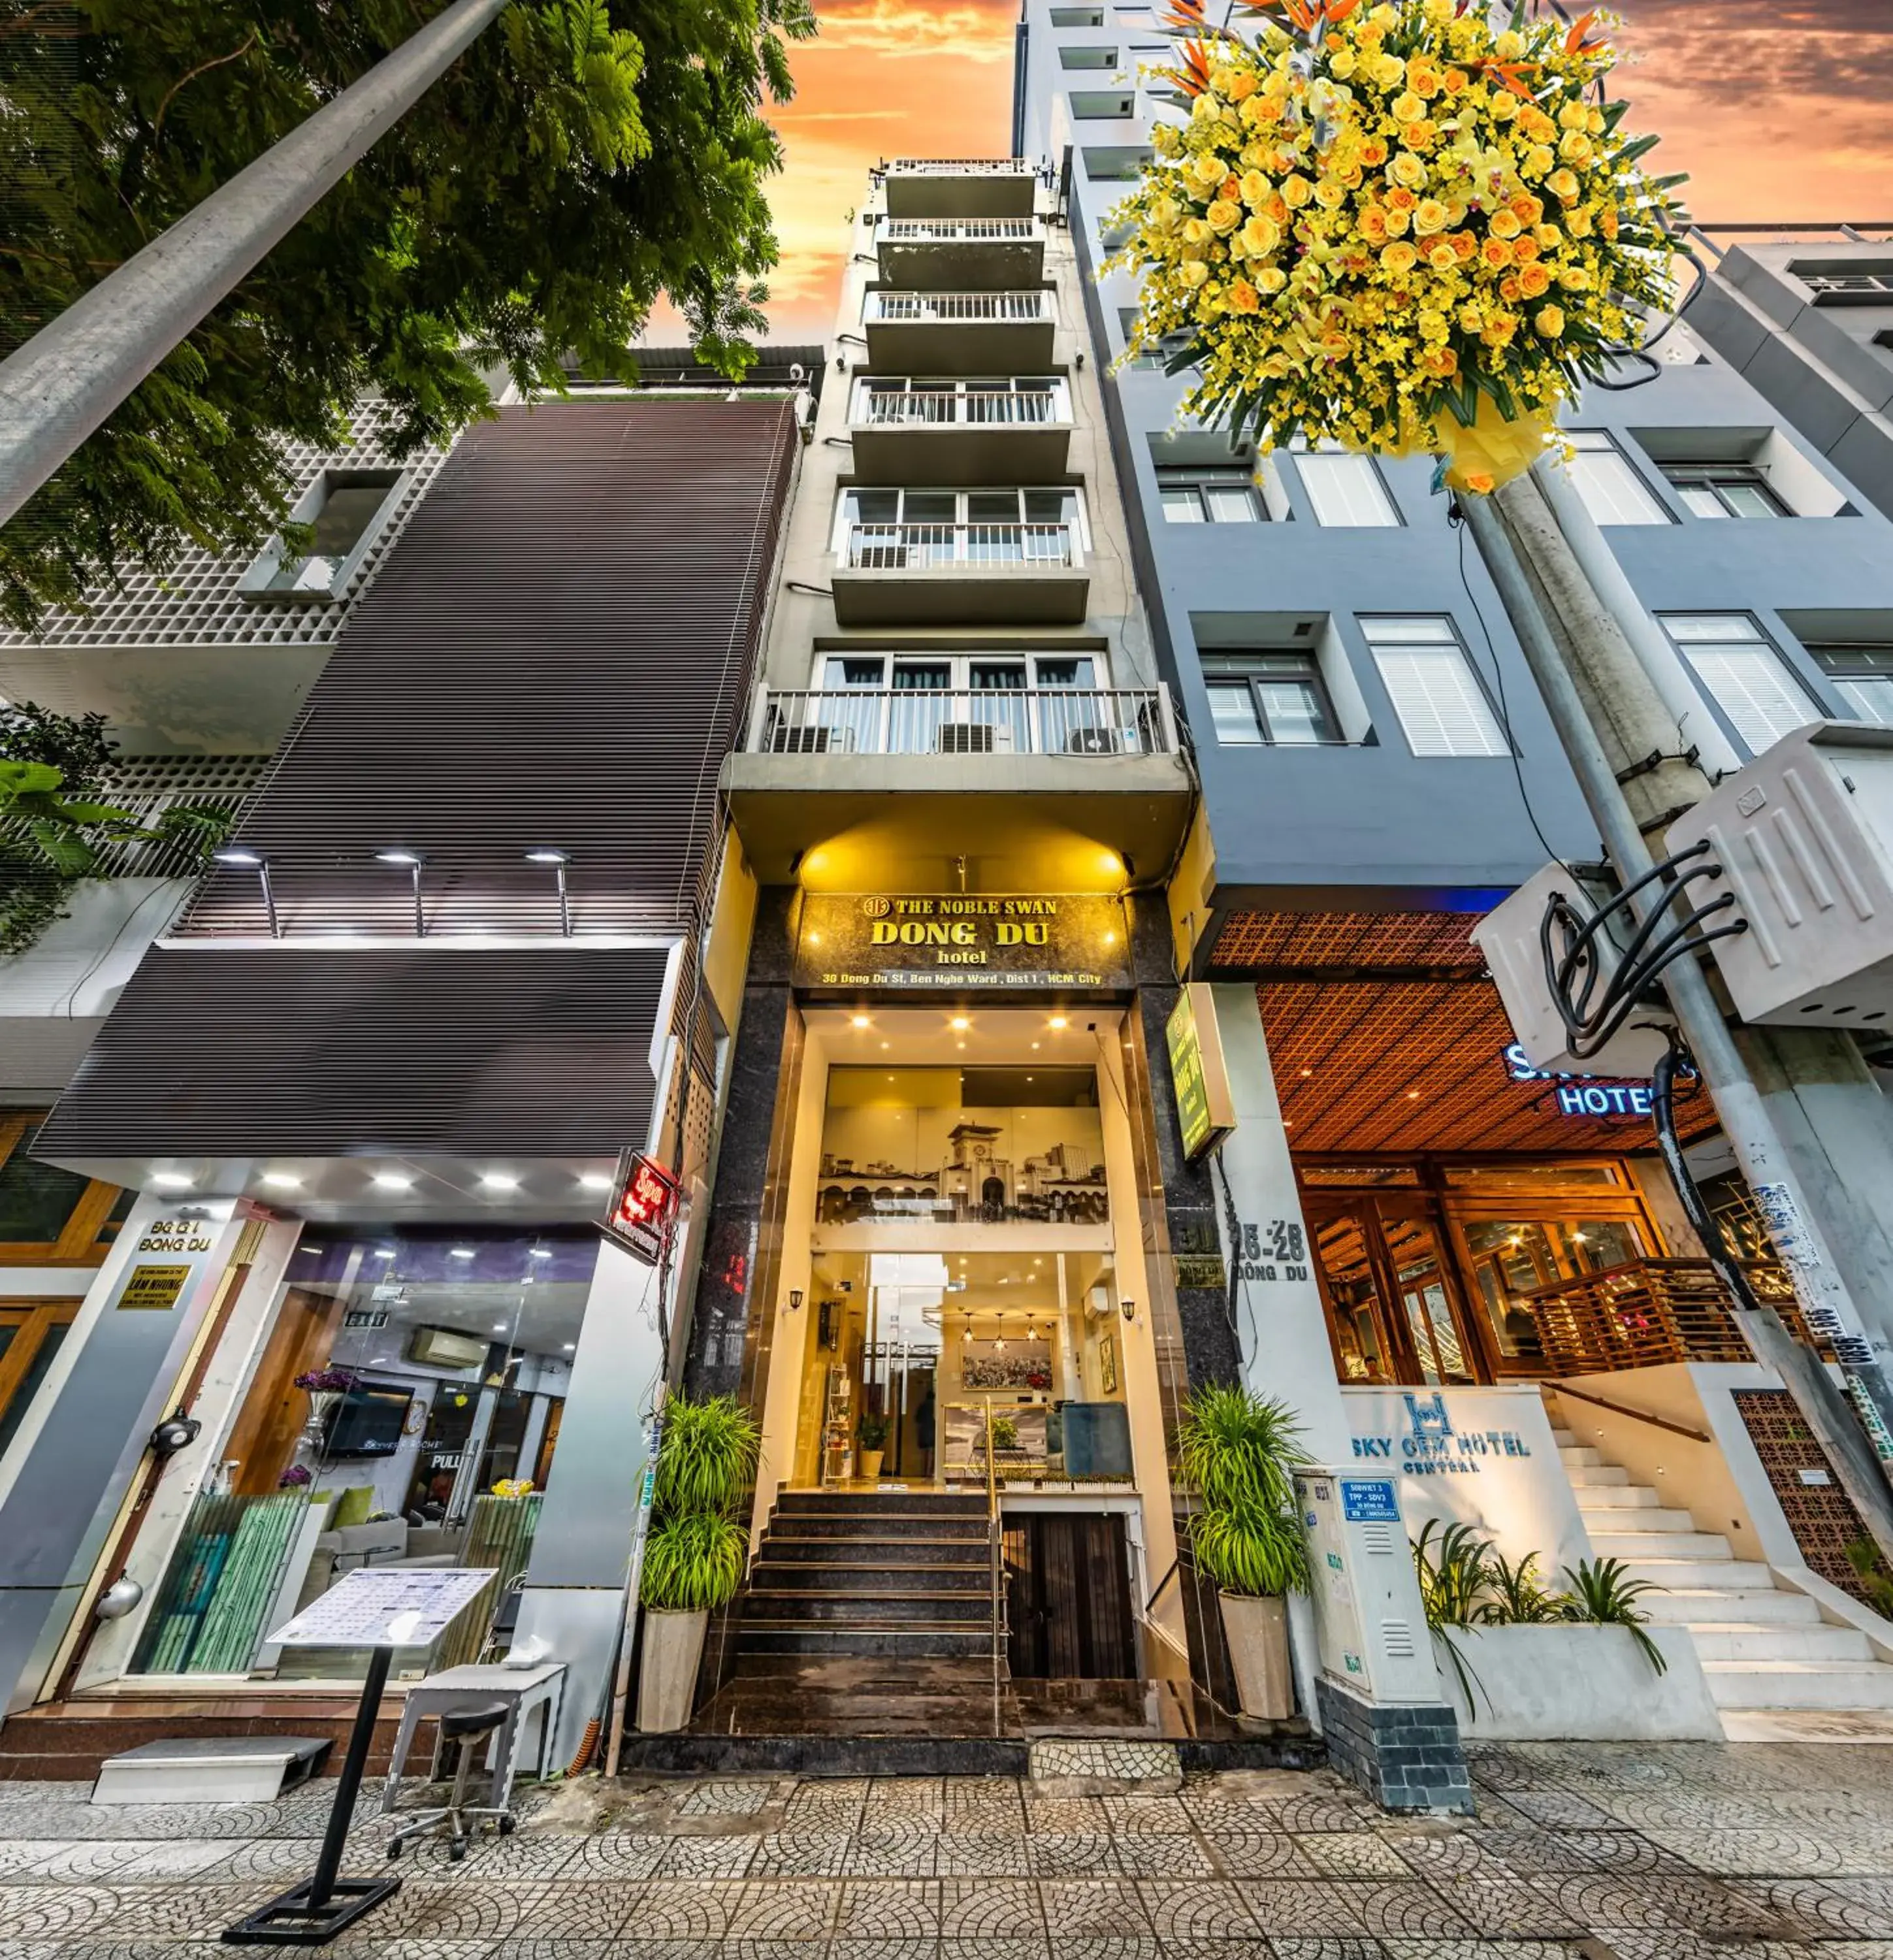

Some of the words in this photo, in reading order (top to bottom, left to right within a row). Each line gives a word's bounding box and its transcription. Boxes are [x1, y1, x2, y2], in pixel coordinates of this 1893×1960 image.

[898, 900, 933, 914] THE
[940, 900, 999, 914] NOBLE
[1005, 900, 1056, 914] SWAN
[870, 922, 978, 945] DONG
[995, 923, 1049, 945] DU
[937, 950, 988, 964] hotel
[841, 974, 870, 985] Dong
[873, 974, 888, 984] Du
[911, 974, 932, 984] Ben
[935, 974, 963, 986] Nghe
[1007, 974, 1029, 984] Dist
[1048, 974, 1074, 984] HCM
[1078, 974, 1102, 985] City
[1559, 1087, 1655, 1113] HOTE
[635, 1166, 664, 1206] Spa
[188, 1238, 211, 1252] DU
[1285, 1266, 1308, 1281] DU
[1351, 1437, 1392, 1458] SKY
[1457, 1431, 1532, 1456] HOTEL
[1349, 1493, 1363, 1501] TPP
